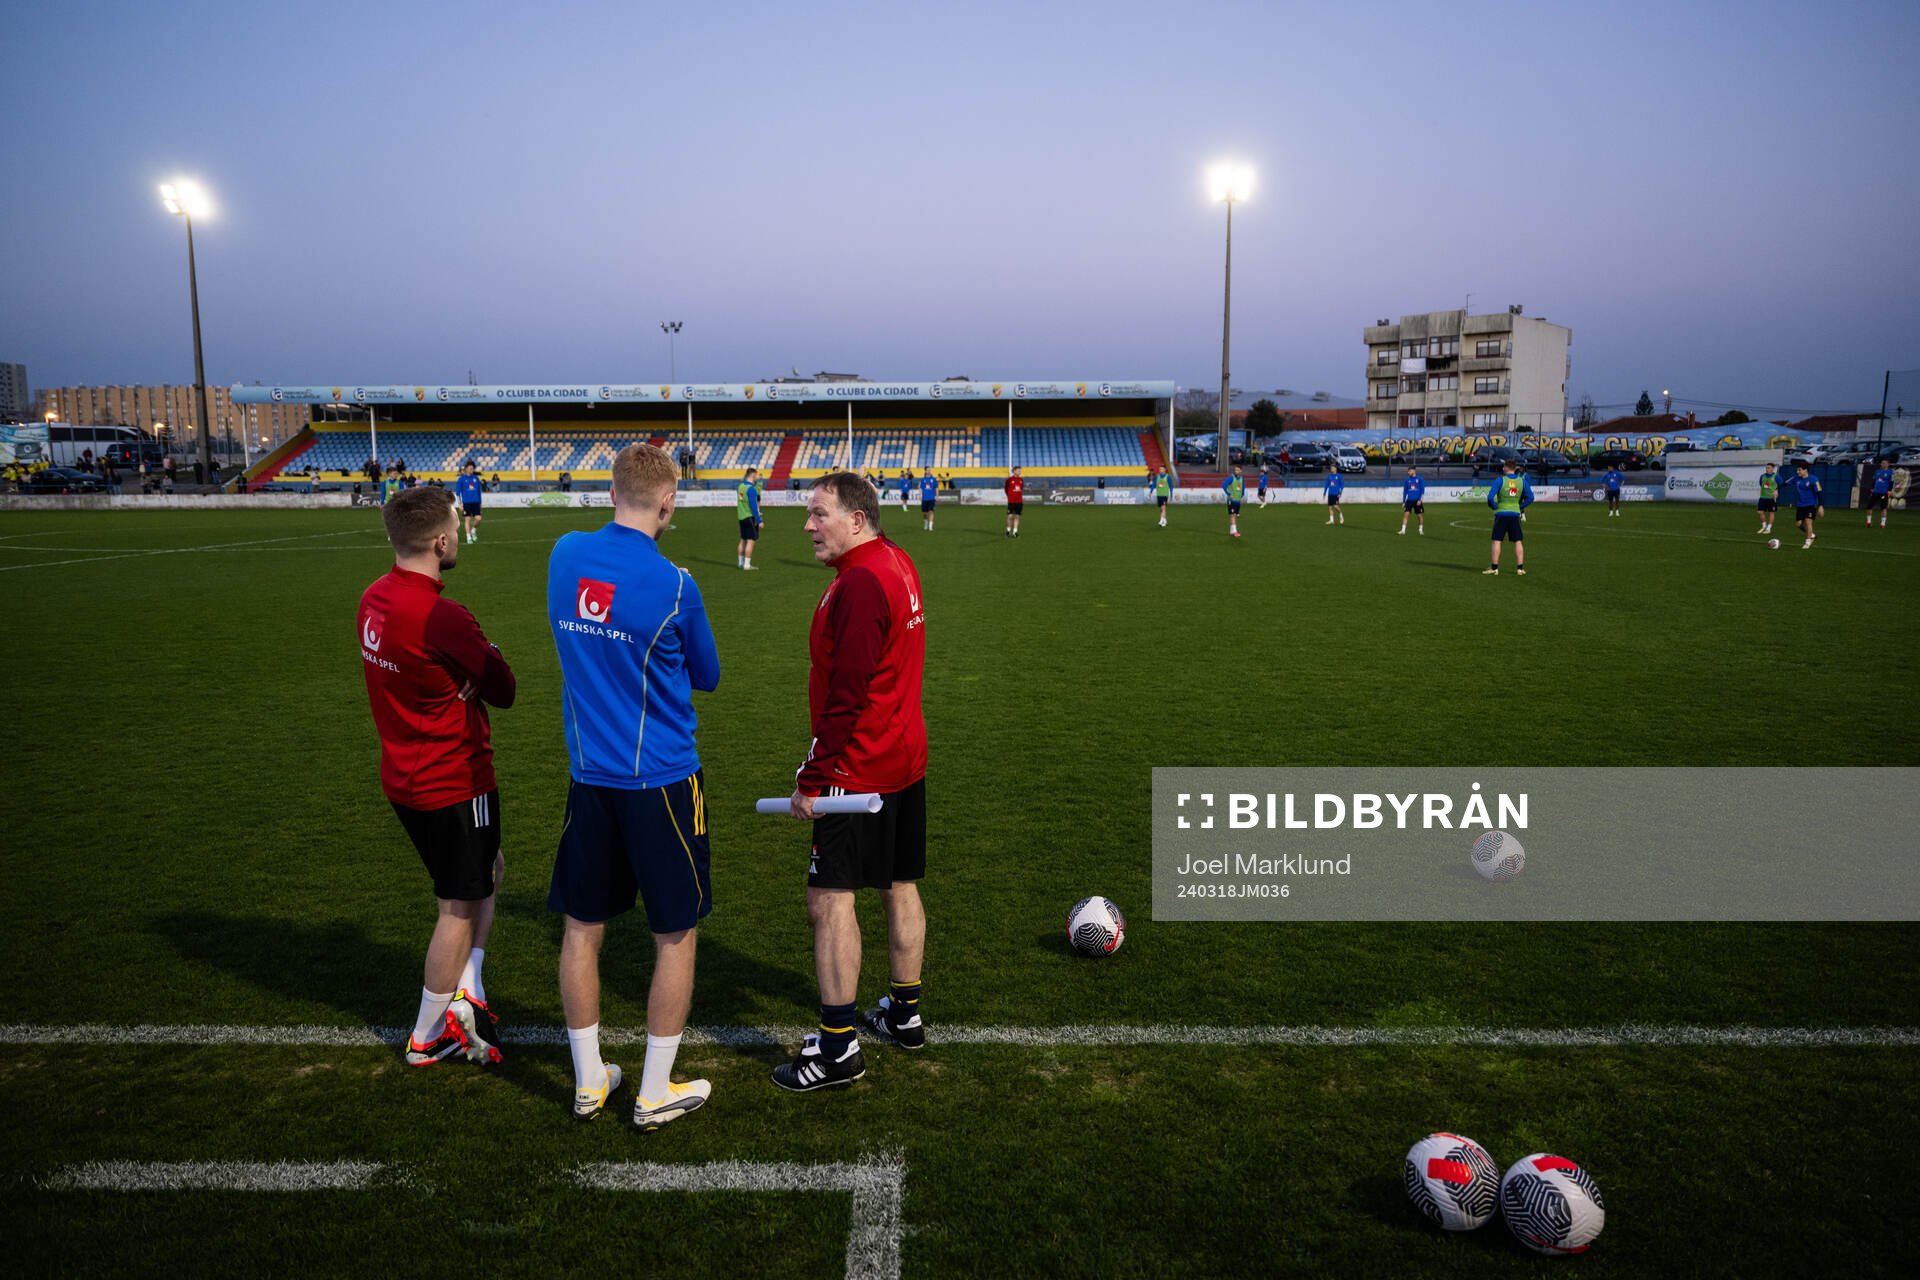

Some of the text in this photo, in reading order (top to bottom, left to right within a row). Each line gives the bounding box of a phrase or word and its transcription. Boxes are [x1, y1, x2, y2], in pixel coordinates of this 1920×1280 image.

[497, 388, 505, 397] O
[506, 388, 537, 397] CLUBE
[538, 388, 551, 397] DA
[553, 388, 588, 397] CIDADE
[827, 387, 834, 396] O
[835, 387, 866, 396] CLUBE
[868, 387, 882, 396] DA
[884, 387, 919, 396] CIDADE
[1520, 434, 1594, 456] SPORT
[1103, 490, 1131, 498] TOYO
[1055, 495, 1091, 503] PLAYOFF
[1107, 497, 1136, 505] TIRES
[558, 620, 635, 644] SVENSKA SPEL
[379, 658, 401, 673] SPEL
